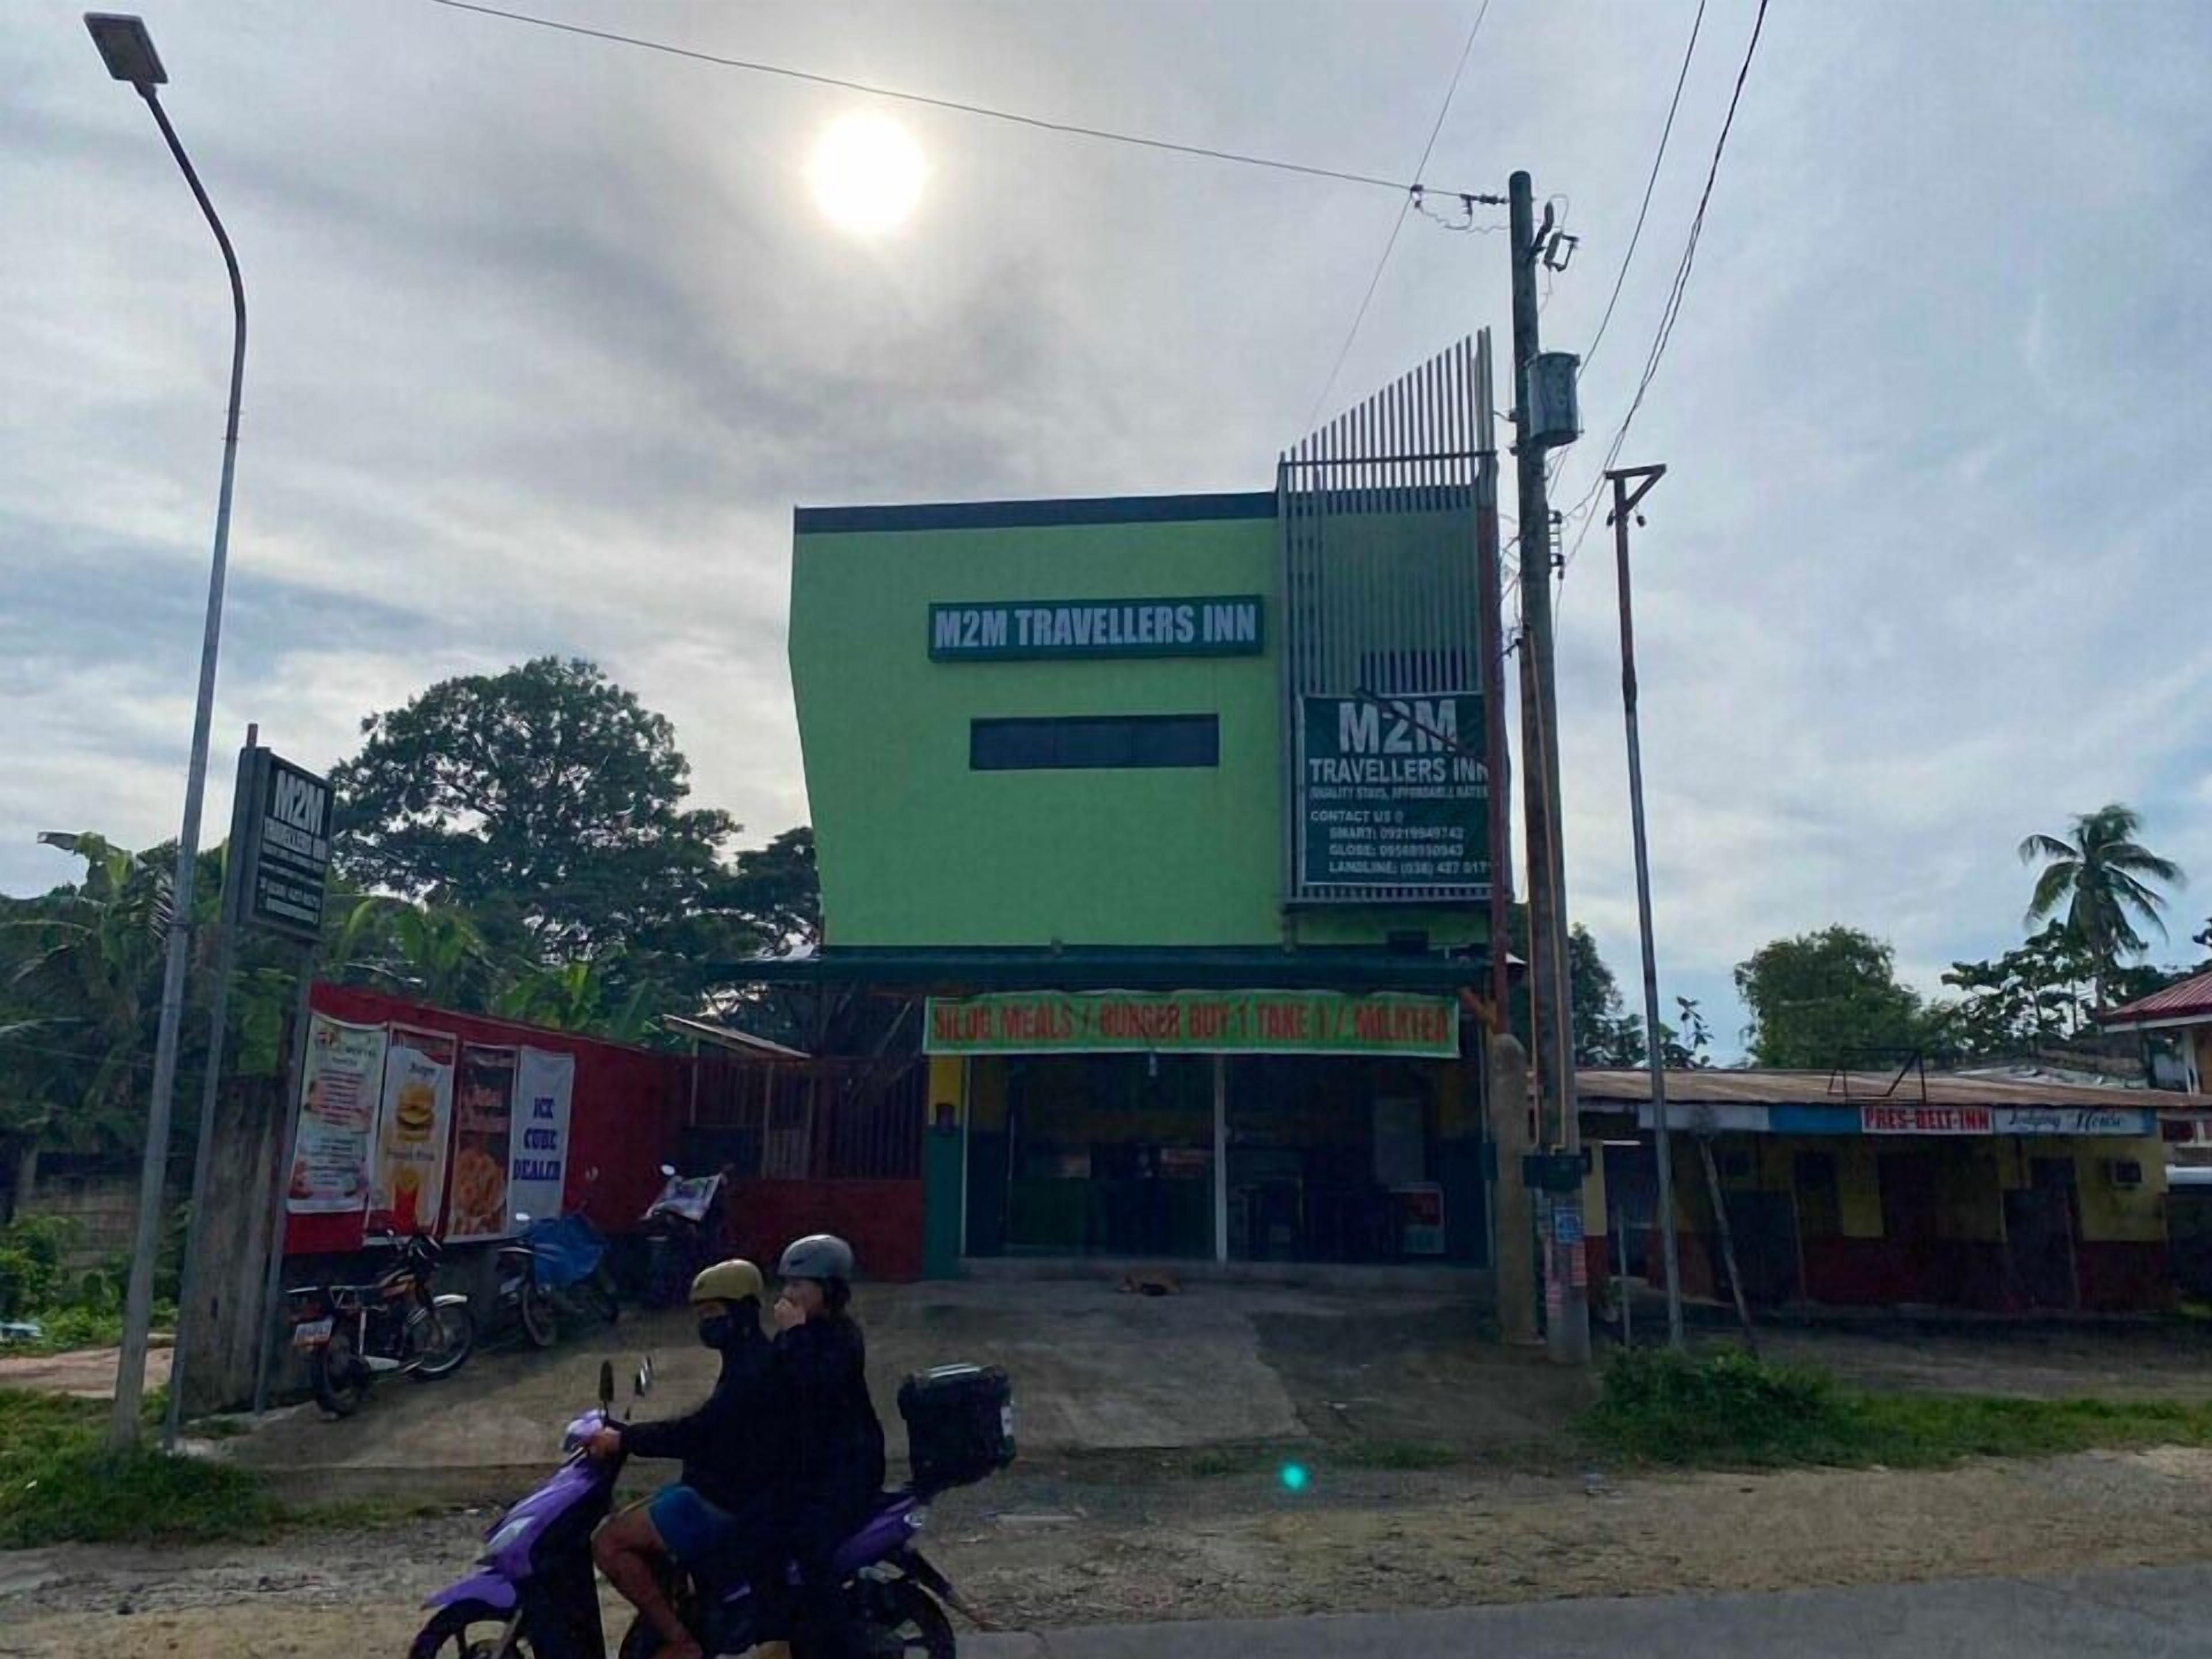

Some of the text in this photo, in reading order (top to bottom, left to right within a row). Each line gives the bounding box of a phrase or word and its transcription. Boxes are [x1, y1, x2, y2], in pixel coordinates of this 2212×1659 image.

[935, 604, 1256, 648] M2M TRAVELLERS INN
[1339, 699, 1458, 753] M2M
[1309, 758, 1446, 784] TRAVELLERS
[274, 770, 325, 835] M2M
[1310, 810, 1370, 823] CONTACT
[1373, 810, 1391, 823] US
